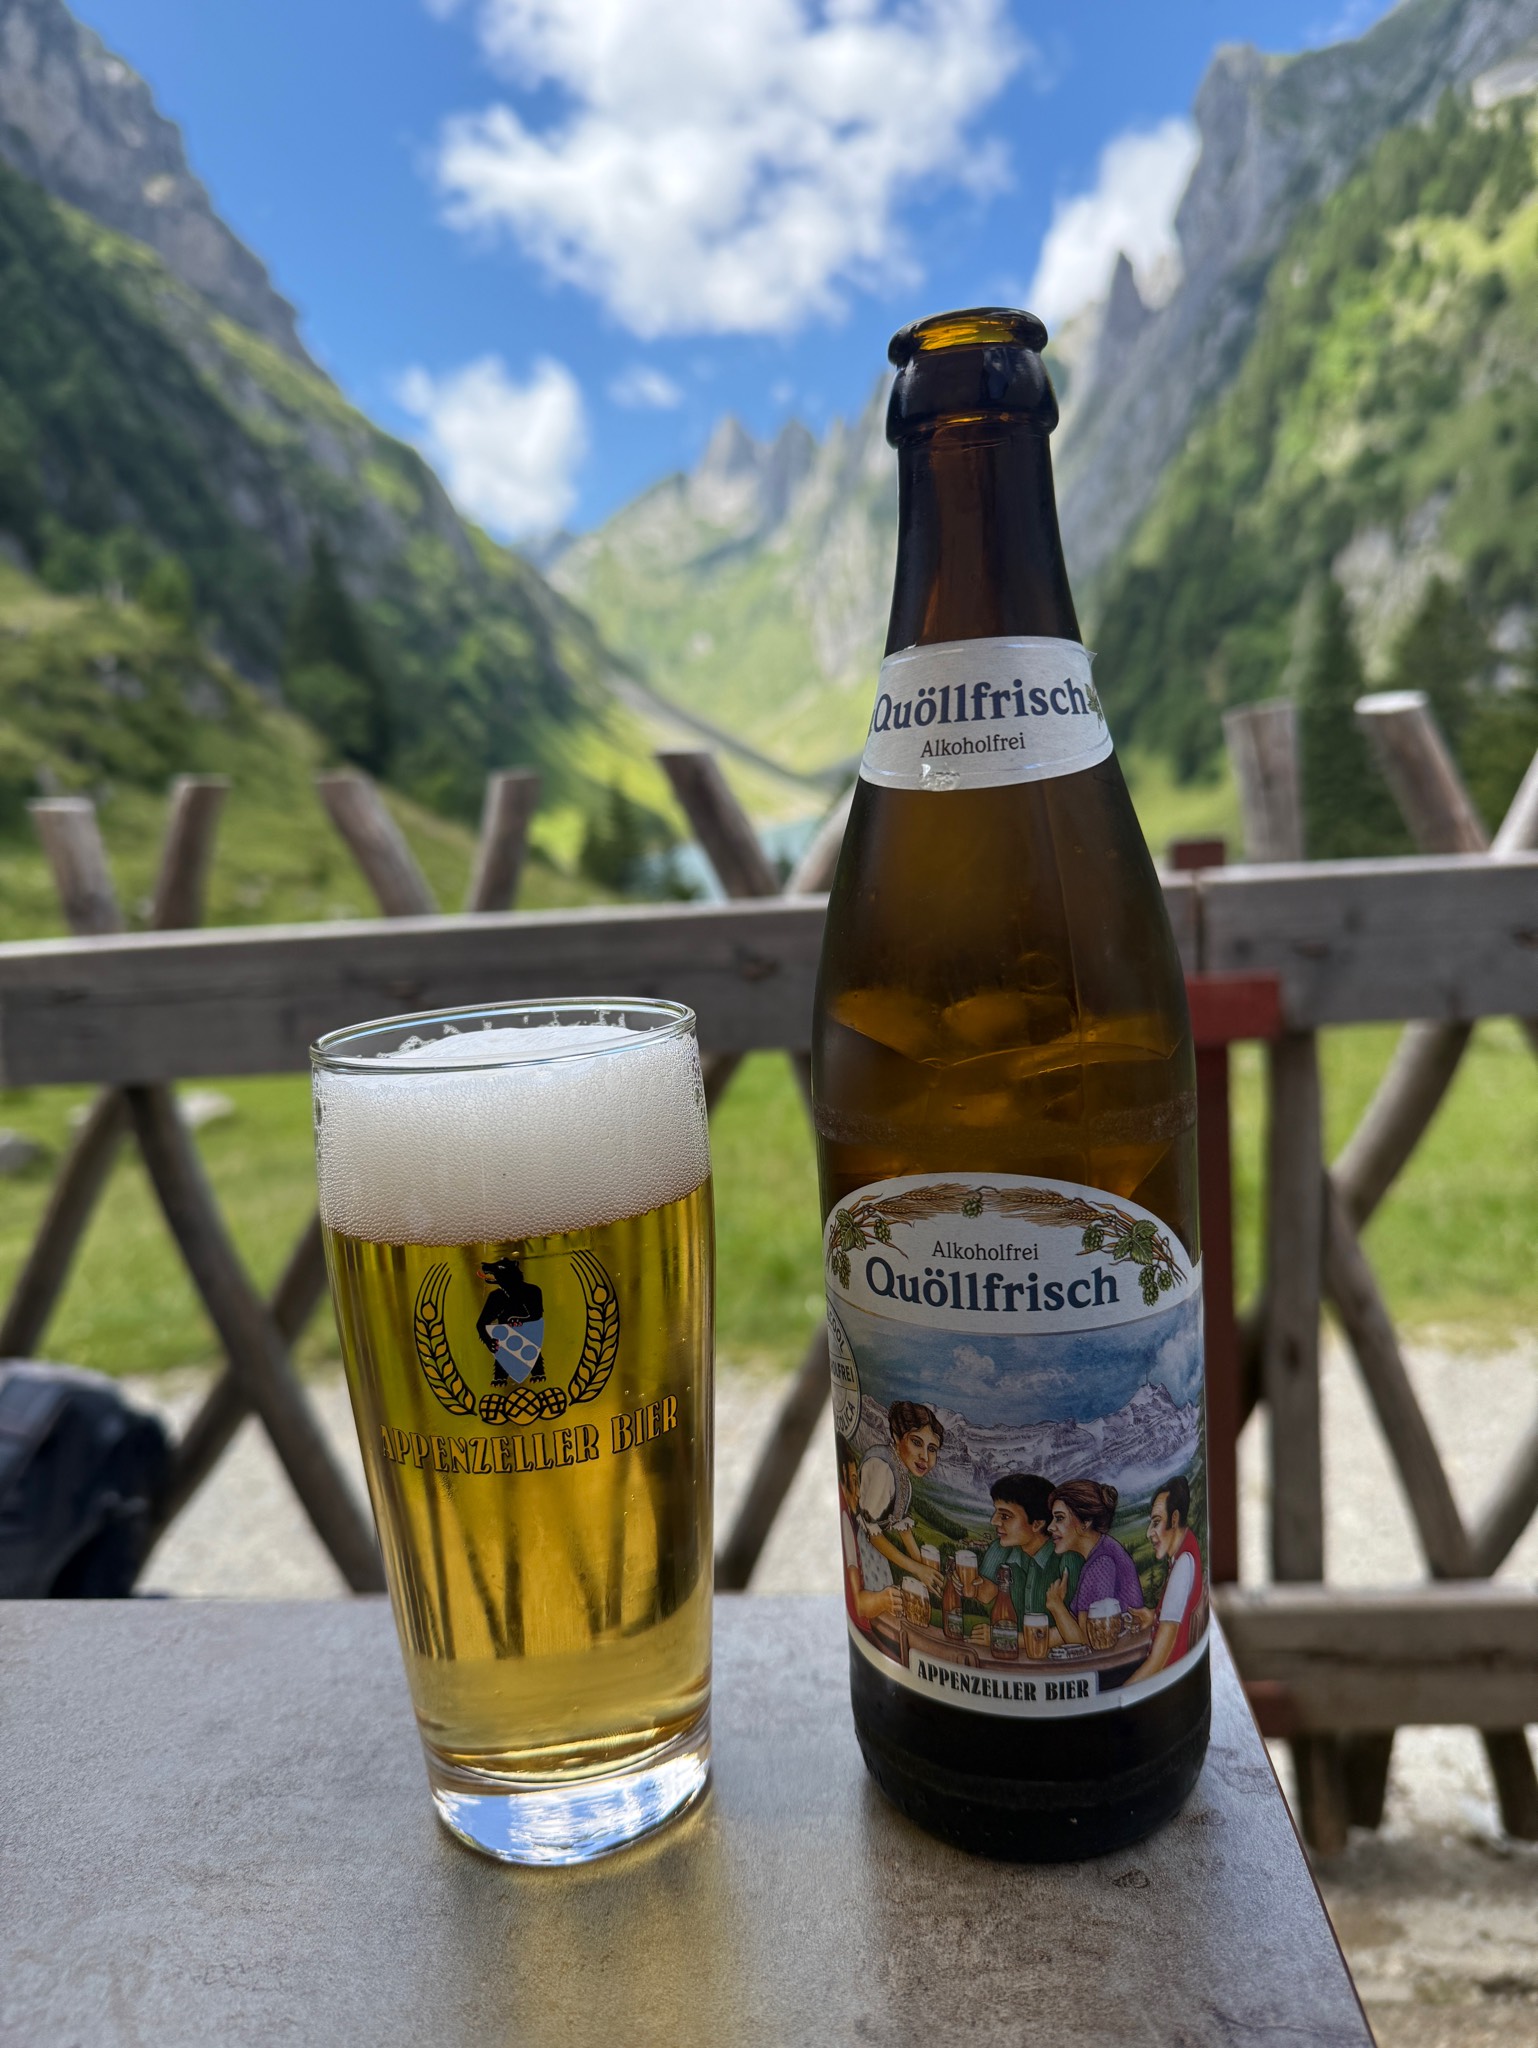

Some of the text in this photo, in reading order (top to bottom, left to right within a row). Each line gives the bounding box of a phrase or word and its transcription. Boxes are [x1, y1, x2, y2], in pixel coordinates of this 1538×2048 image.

[874, 678, 1090, 733] Quöllfrisch
[920, 732, 1026, 758] Alkoholfrei
[932, 1240, 1039, 1262] Alkoholfrei
[866, 1257, 1120, 1313] Quöllfrisch
[380, 1394, 679, 1475] APPENZELLER BIER
[917, 1659, 1090, 1702] APPENZELLER BIER
